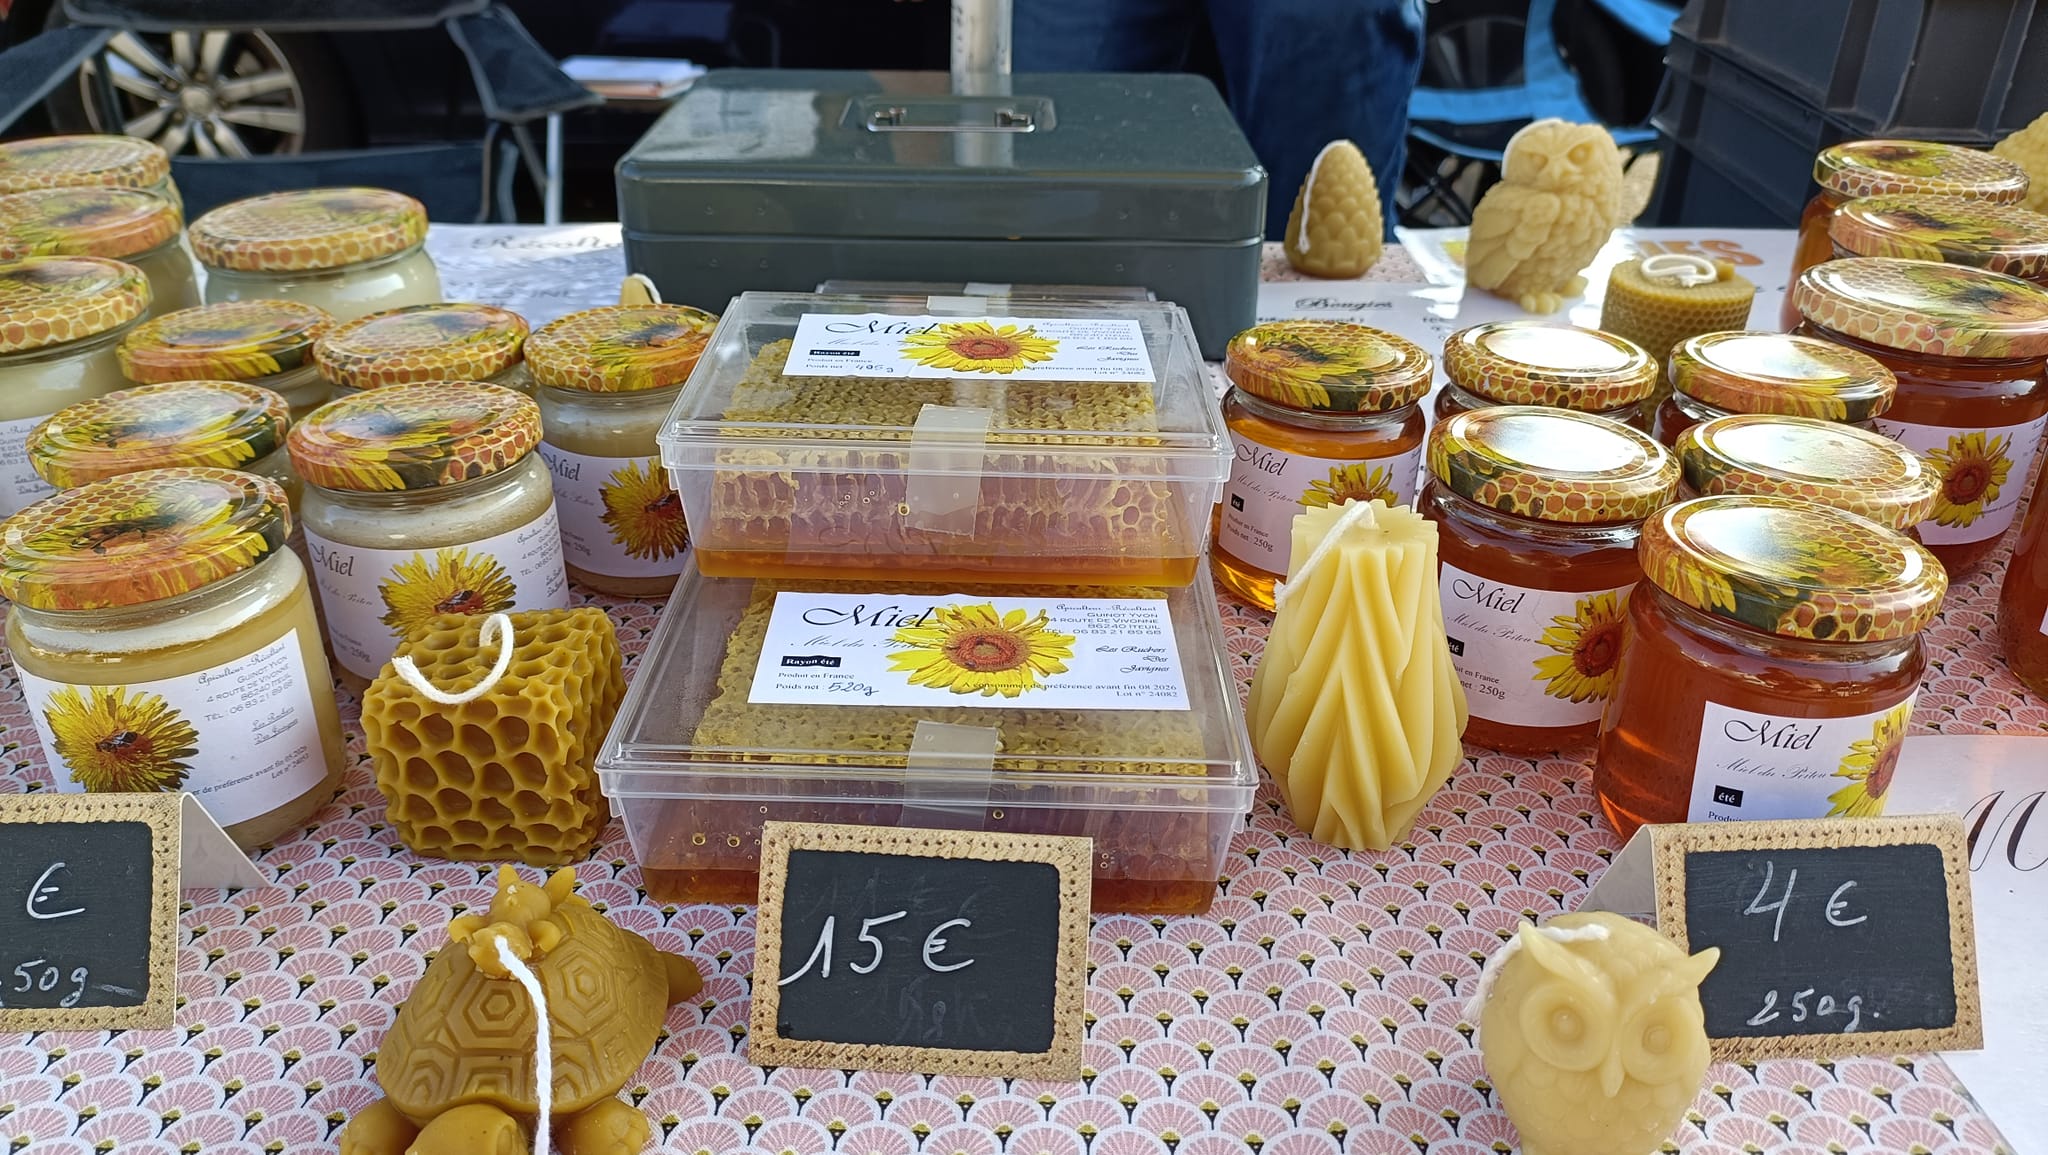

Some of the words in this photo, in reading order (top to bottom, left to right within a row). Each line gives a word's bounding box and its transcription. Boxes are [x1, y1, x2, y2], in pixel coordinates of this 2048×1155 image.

[825, 320, 939, 335] Miel
[543, 452, 581, 481] Miel
[1236, 443, 1289, 477] Miel
[1253, 537, 1274, 553] 250g
[309, 542, 355, 577] Miel
[1452, 578, 1526, 614] Miel
[802, 604, 936, 628] Miel
[1056, 603, 1102, 612] Apiculteur
[1493, 624, 1531, 643] Poitou
[349, 645, 372, 663] 250g
[785, 658, 818, 667] Rayon
[819, 658, 836, 666] été
[198, 666, 244, 686] Apiculteur
[237, 665, 269, 684] GUINOT
[1475, 671, 1500, 684] France
[215, 685, 246, 701] ROUTE
[246, 679, 258, 690] DE
[240, 683, 271, 701] 86240
[775, 682, 803, 690] Poids
[828, 681, 880, 697] 520g
[1043, 683, 1092, 691] préférence
[1479, 683, 1506, 700] 250g
[229, 703, 244, 714] 06
[1723, 719, 1824, 751] Miel
[271, 769, 283, 779] Lot
[1716, 757, 1758, 776] Miel
[1756, 765, 1775, 777] du
[1781, 763, 1827, 780] Poitou
[202, 786, 213, 795] de
[214, 773, 254, 792] préférence
[255, 763, 274, 777] avant
[1718, 792, 1735, 803] été
[26, 862, 86, 919] €
[1743, 860, 1798, 942] 4
[1825, 880, 1868, 927] €
[0, 958, 89, 1008] 50g
